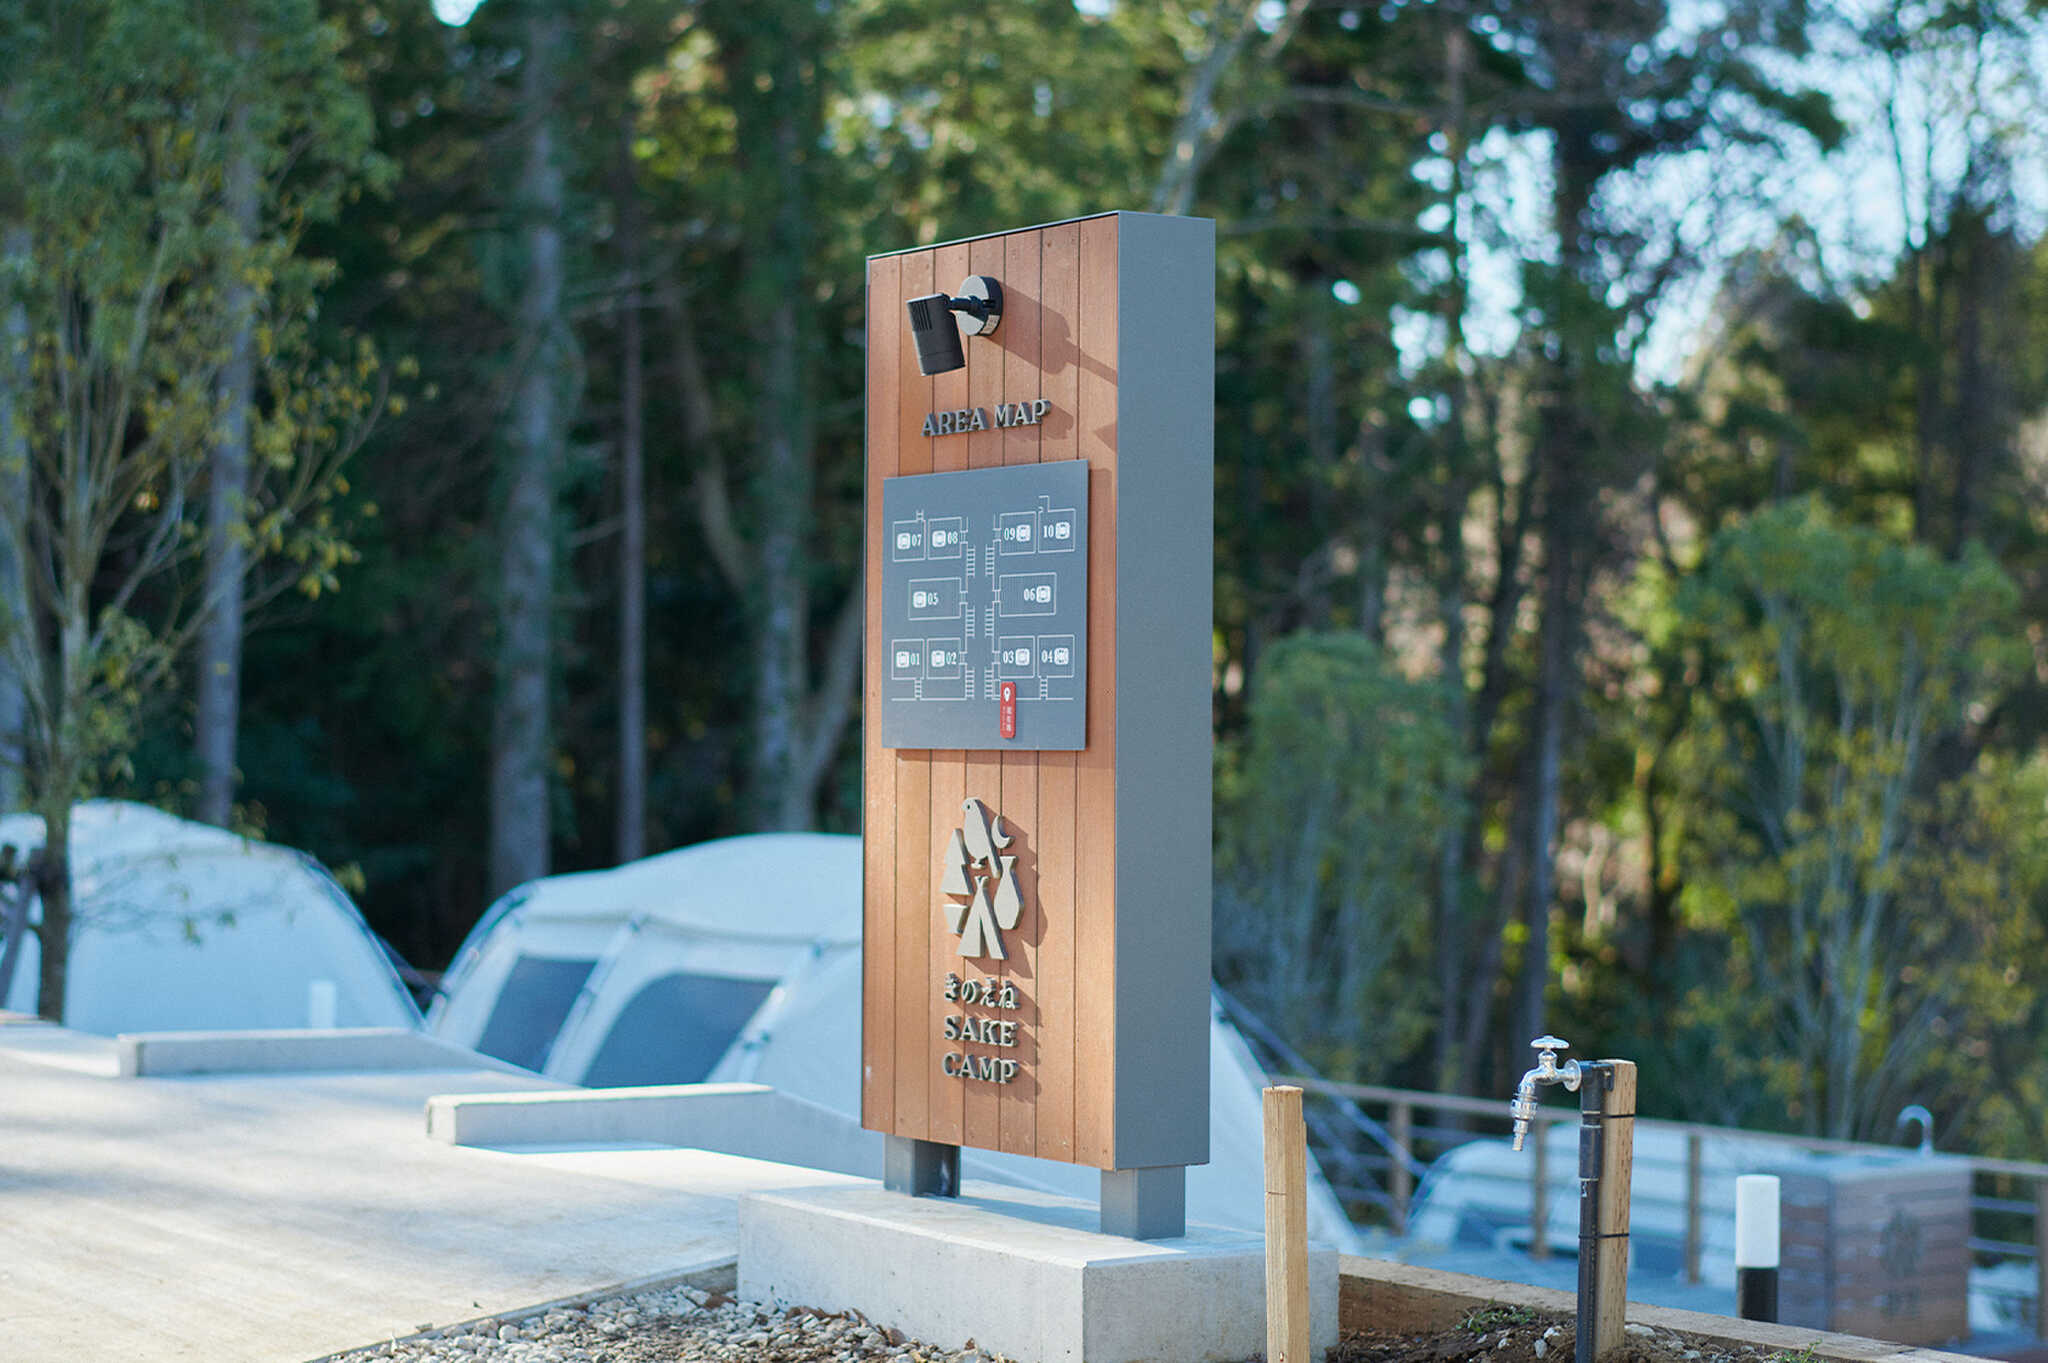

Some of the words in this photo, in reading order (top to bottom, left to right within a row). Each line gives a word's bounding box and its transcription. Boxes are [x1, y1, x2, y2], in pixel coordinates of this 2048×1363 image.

[920, 407, 988, 437] AREA
[994, 399, 1050, 428] MAP
[947, 531, 958, 544] 08
[1004, 527, 1015, 540] 09
[1043, 524, 1054, 538] 10
[911, 534, 921, 547] 07
[928, 592, 939, 605] 05
[1023, 588, 1036, 601] 06
[911, 653, 920, 665] 01
[946, 651, 957, 664] 02
[1003, 650, 1014, 664] 03
[1041, 649, 1053, 663] 04
[944, 972, 1020, 1010] きのえね
[944, 1015, 1018, 1047] SAKE
[942, 1051, 1018, 1084] CAMP
